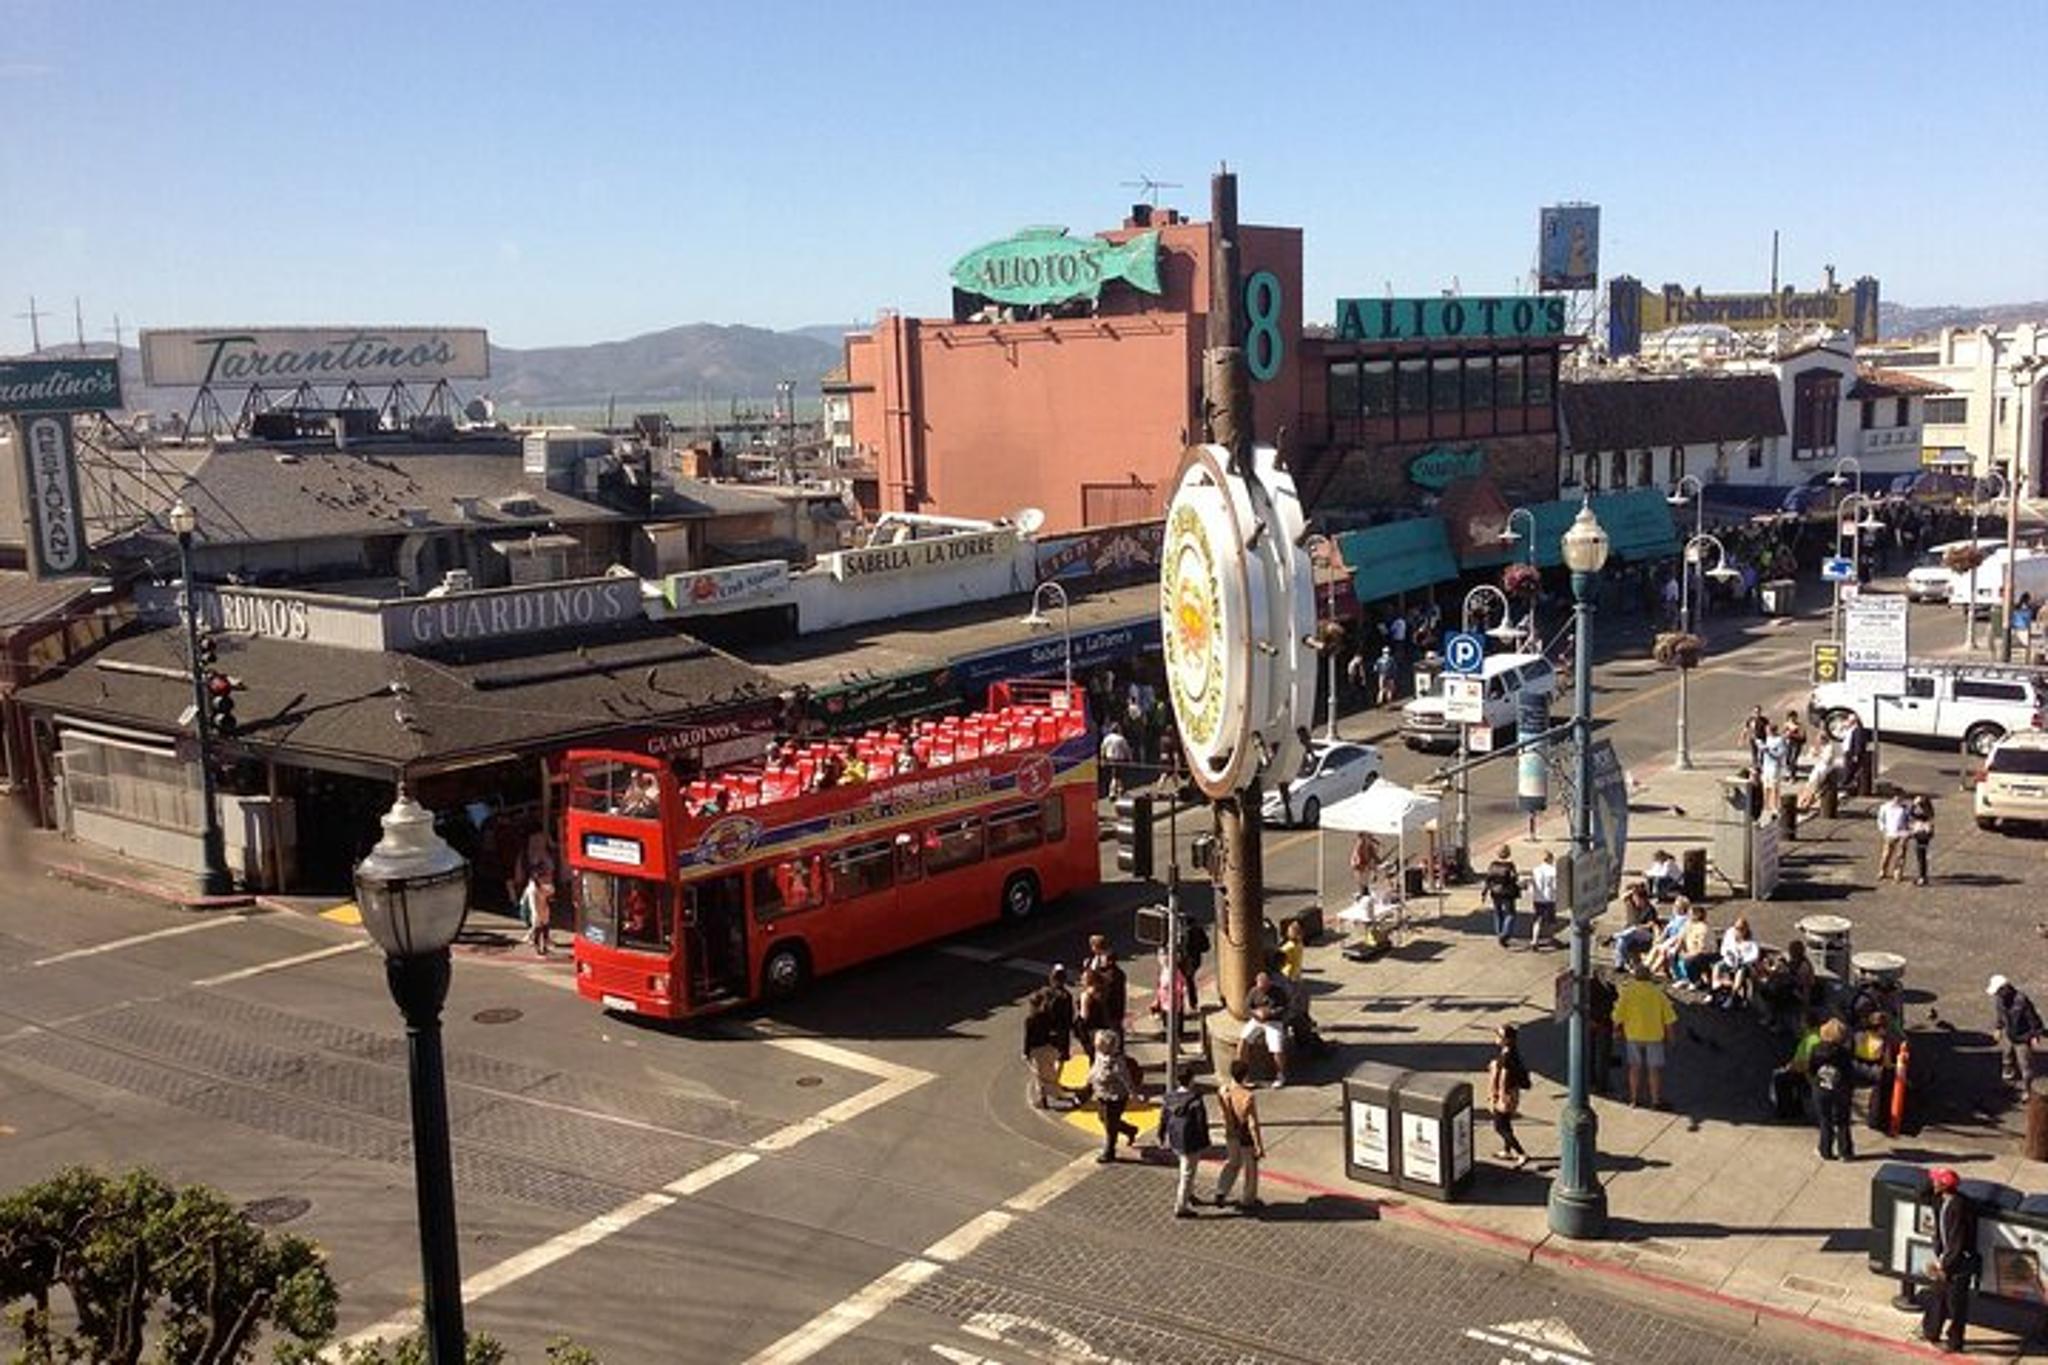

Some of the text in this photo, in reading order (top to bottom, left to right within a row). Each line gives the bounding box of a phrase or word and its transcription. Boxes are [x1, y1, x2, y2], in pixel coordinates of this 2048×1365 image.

[977, 250, 1101, 289] ALIOTO'S
[1245, 271, 1284, 382] 8
[1341, 298, 1566, 339] ALIOTO'S
[195, 336, 455, 382] Tarantino's
[847, 537, 994, 575] SABELLA LA TORRE
[412, 585, 622, 641] GUARDINO'S
[1455, 642, 1474, 666] P
